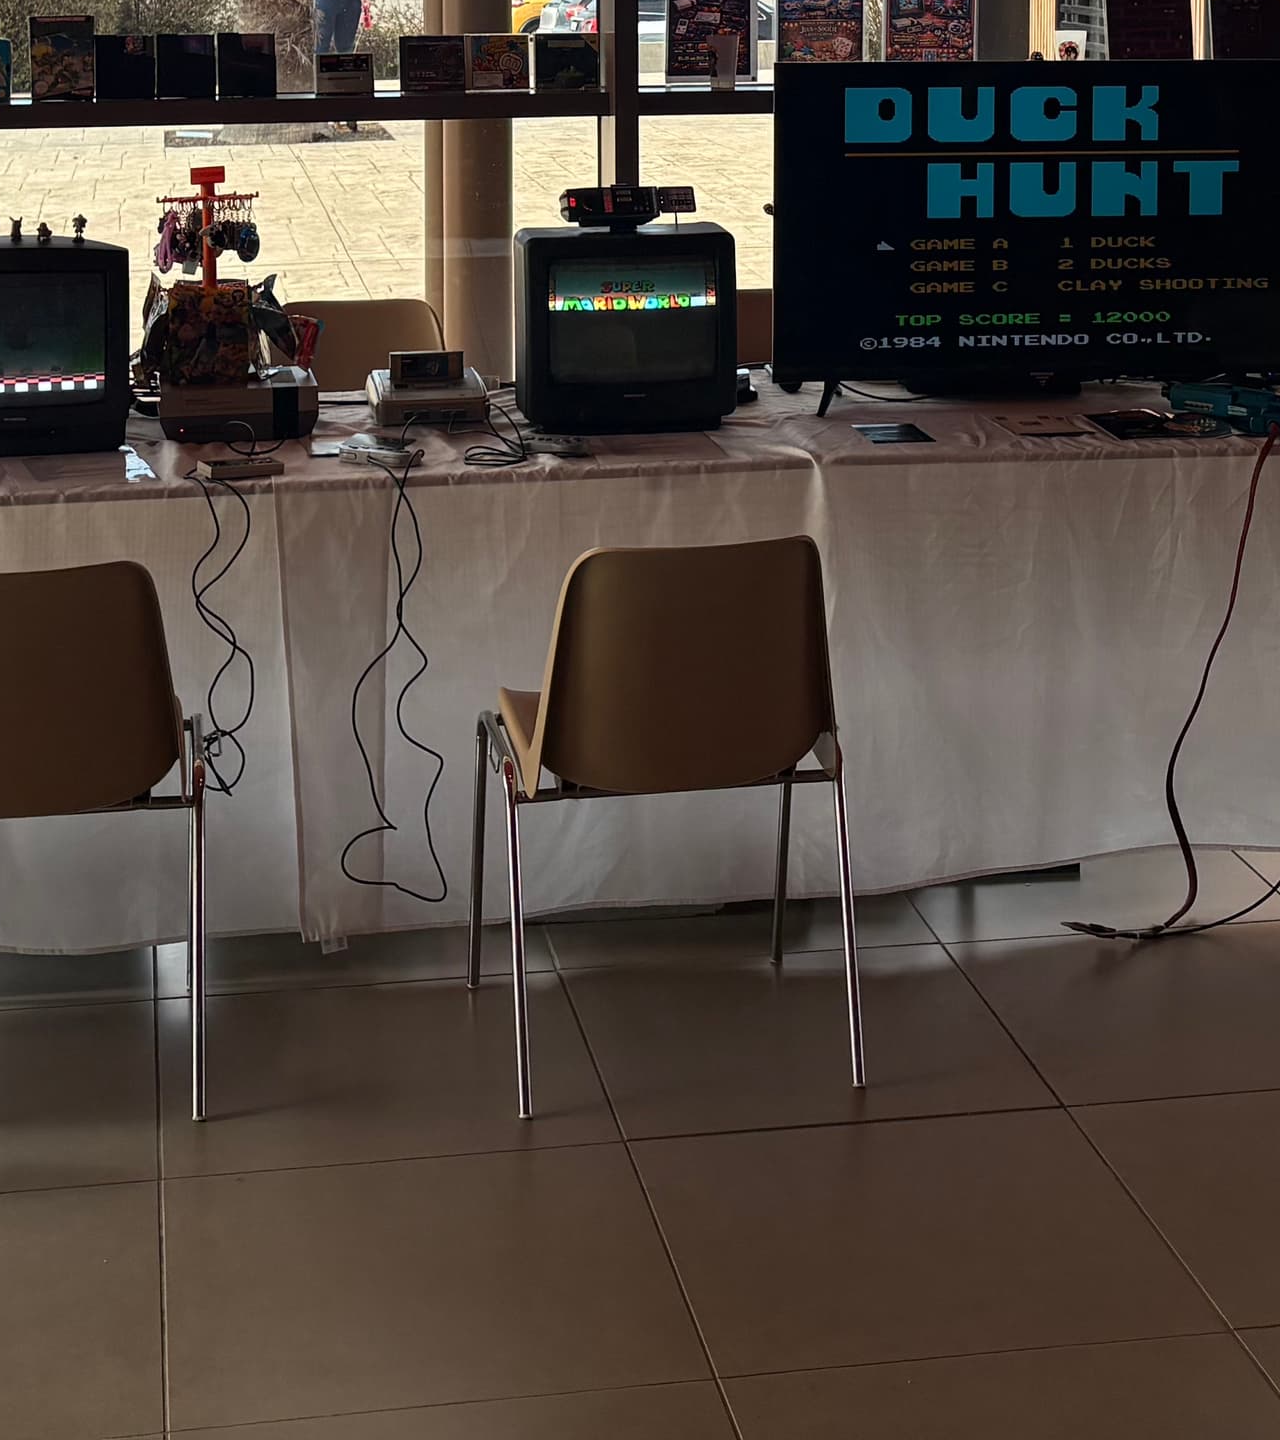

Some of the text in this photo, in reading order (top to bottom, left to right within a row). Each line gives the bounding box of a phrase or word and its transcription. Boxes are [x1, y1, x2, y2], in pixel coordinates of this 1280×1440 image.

[844, 86, 1159, 144] DUCK
[927, 160, 1240, 219] HUNT
[910, 237, 1156, 251] GAME A 1 DUCK
[910, 258, 1172, 272] GAME B 2 DUCKS
[600, 280, 655, 294] SUPER
[910, 277, 1269, 294] GAME C CLAY SHOOTING
[562, 293, 691, 312] MARIO WORLD
[895, 310, 1171, 327] TOP SCORE = 12000
[860, 336, 941, 350] ©1984
[959, 333, 1089, 348] NINTENDO
